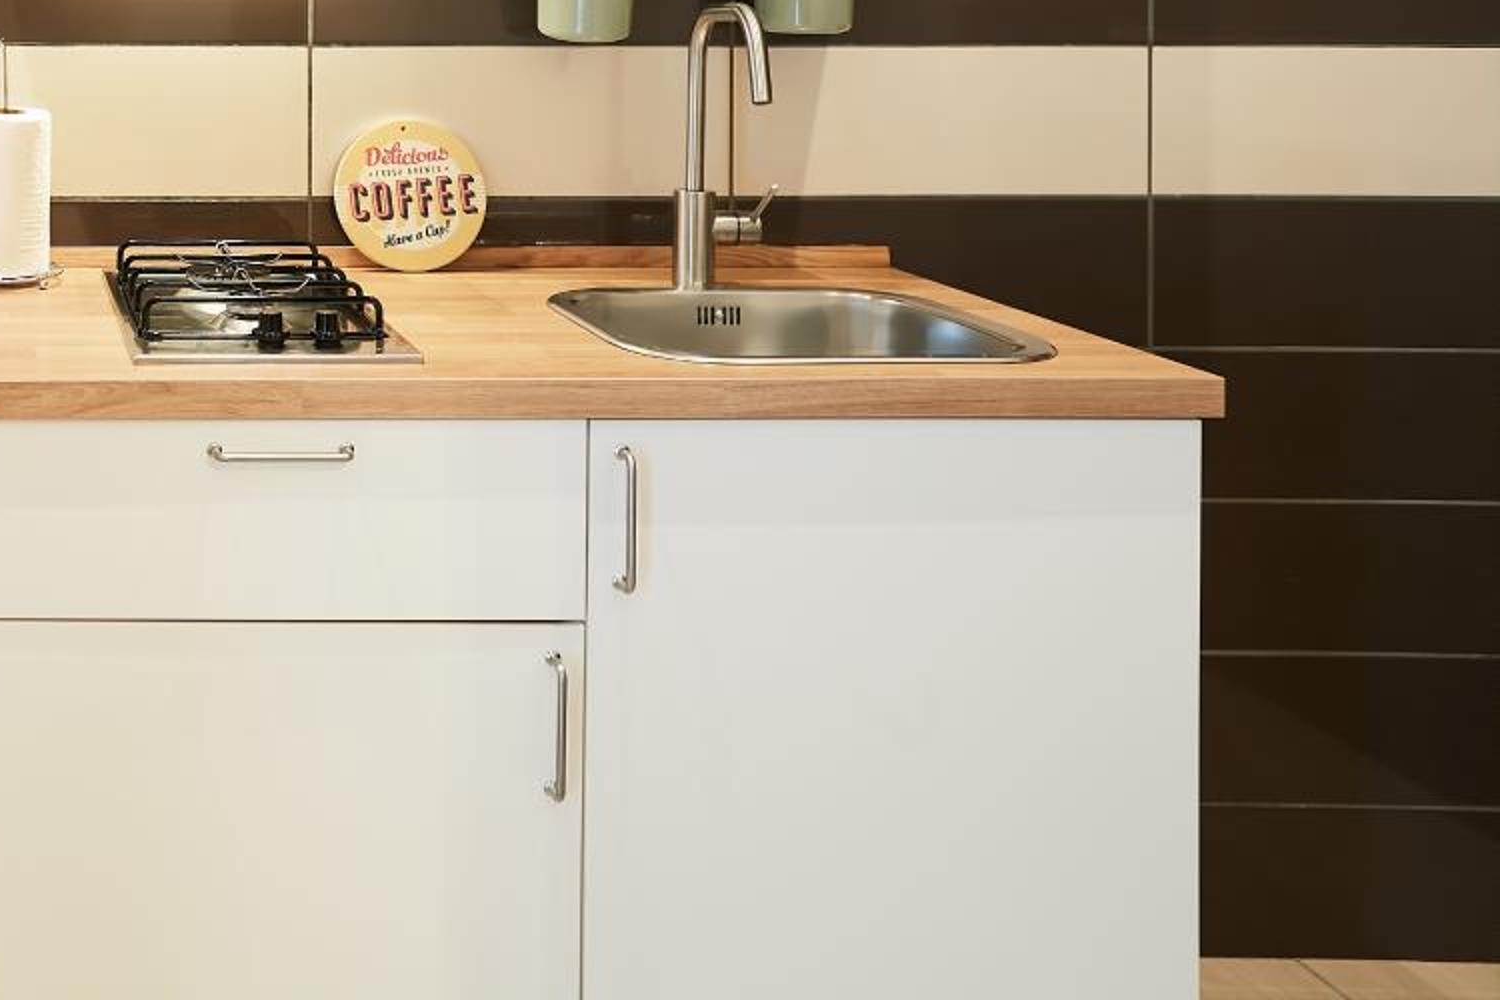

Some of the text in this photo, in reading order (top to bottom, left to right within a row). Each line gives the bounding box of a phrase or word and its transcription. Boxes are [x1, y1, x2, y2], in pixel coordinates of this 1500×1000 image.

[366, 142, 449, 166] Delicious
[349, 174, 479, 222] COFFEE
[384, 232, 413, 248] Have
